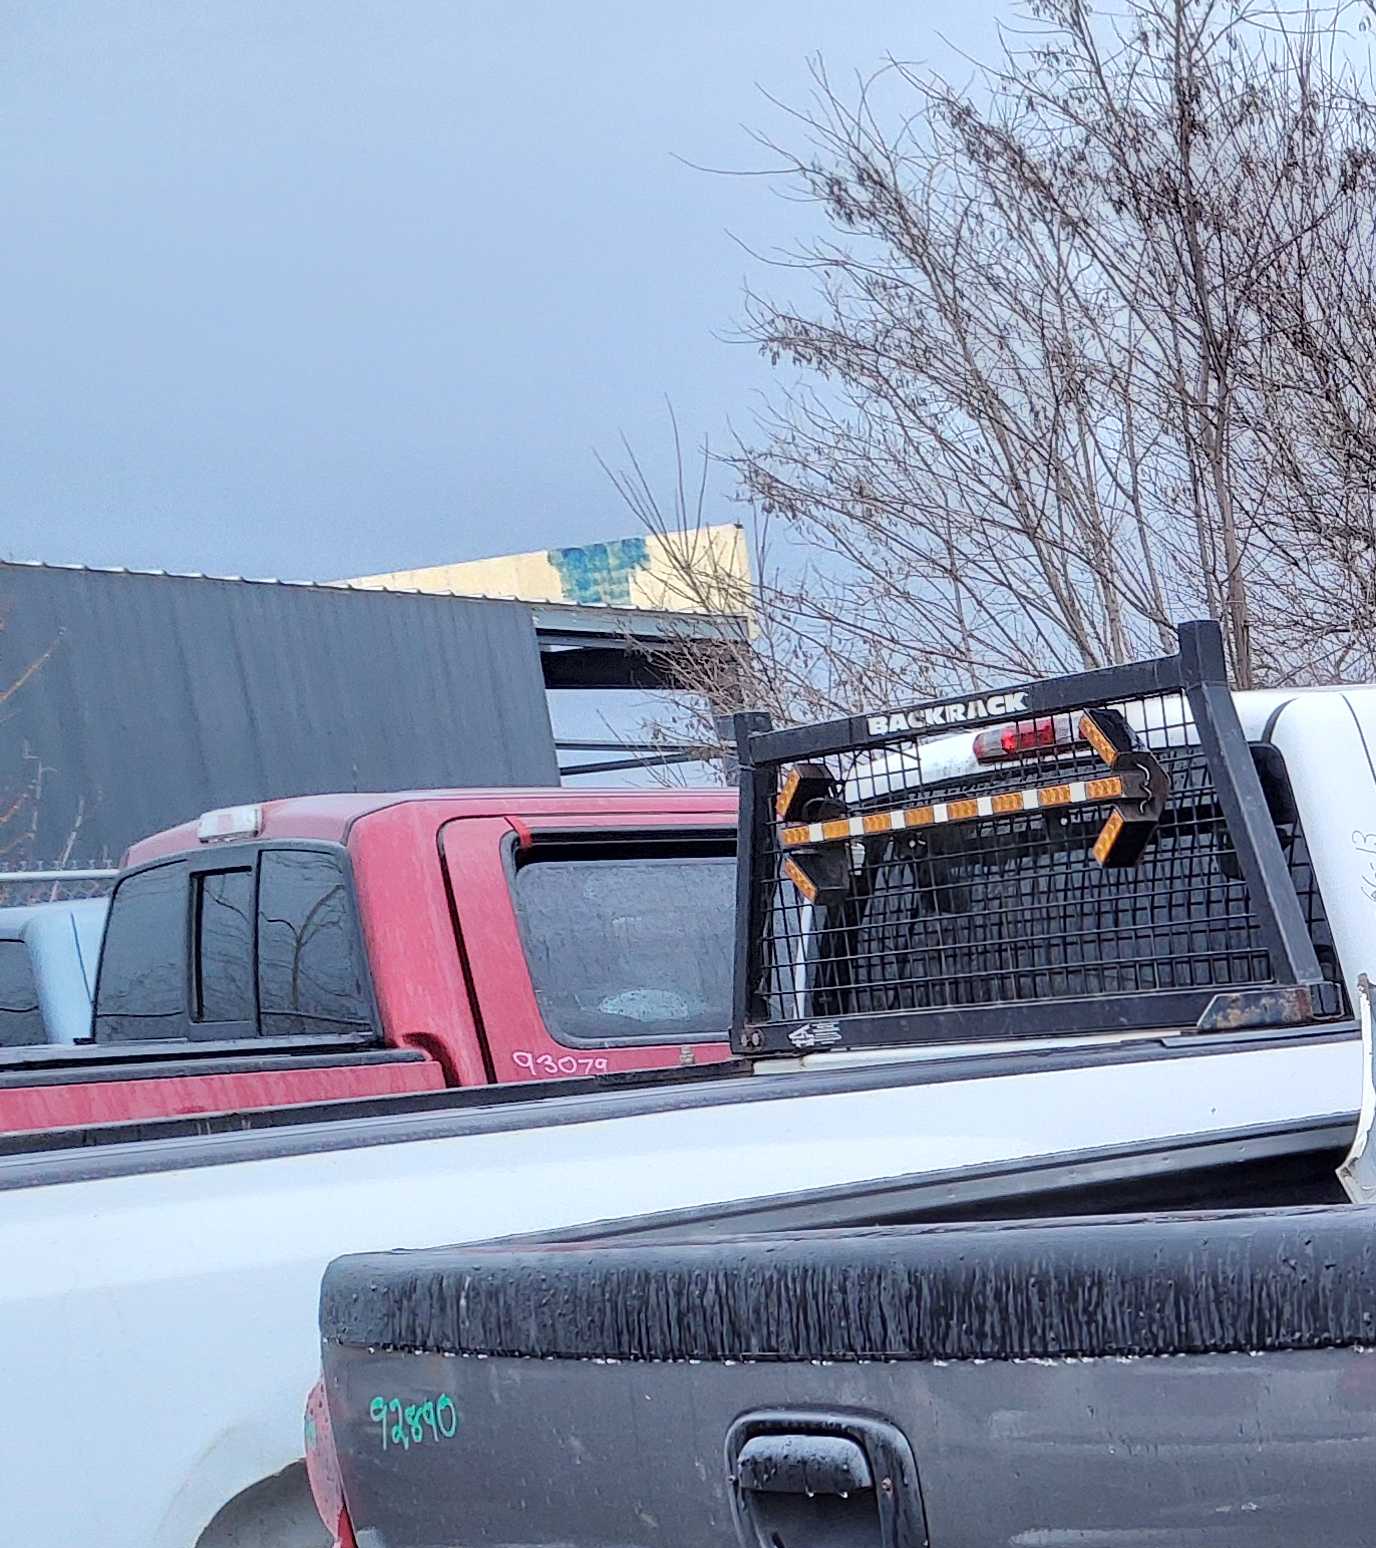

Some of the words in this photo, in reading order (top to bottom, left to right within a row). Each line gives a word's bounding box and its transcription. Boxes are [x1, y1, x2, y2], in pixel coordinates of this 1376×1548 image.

[867, 690, 1031, 736] BACKRACK
[512, 1050, 609, 1076] 93079
[369, 1392, 458, 1452] 92890
